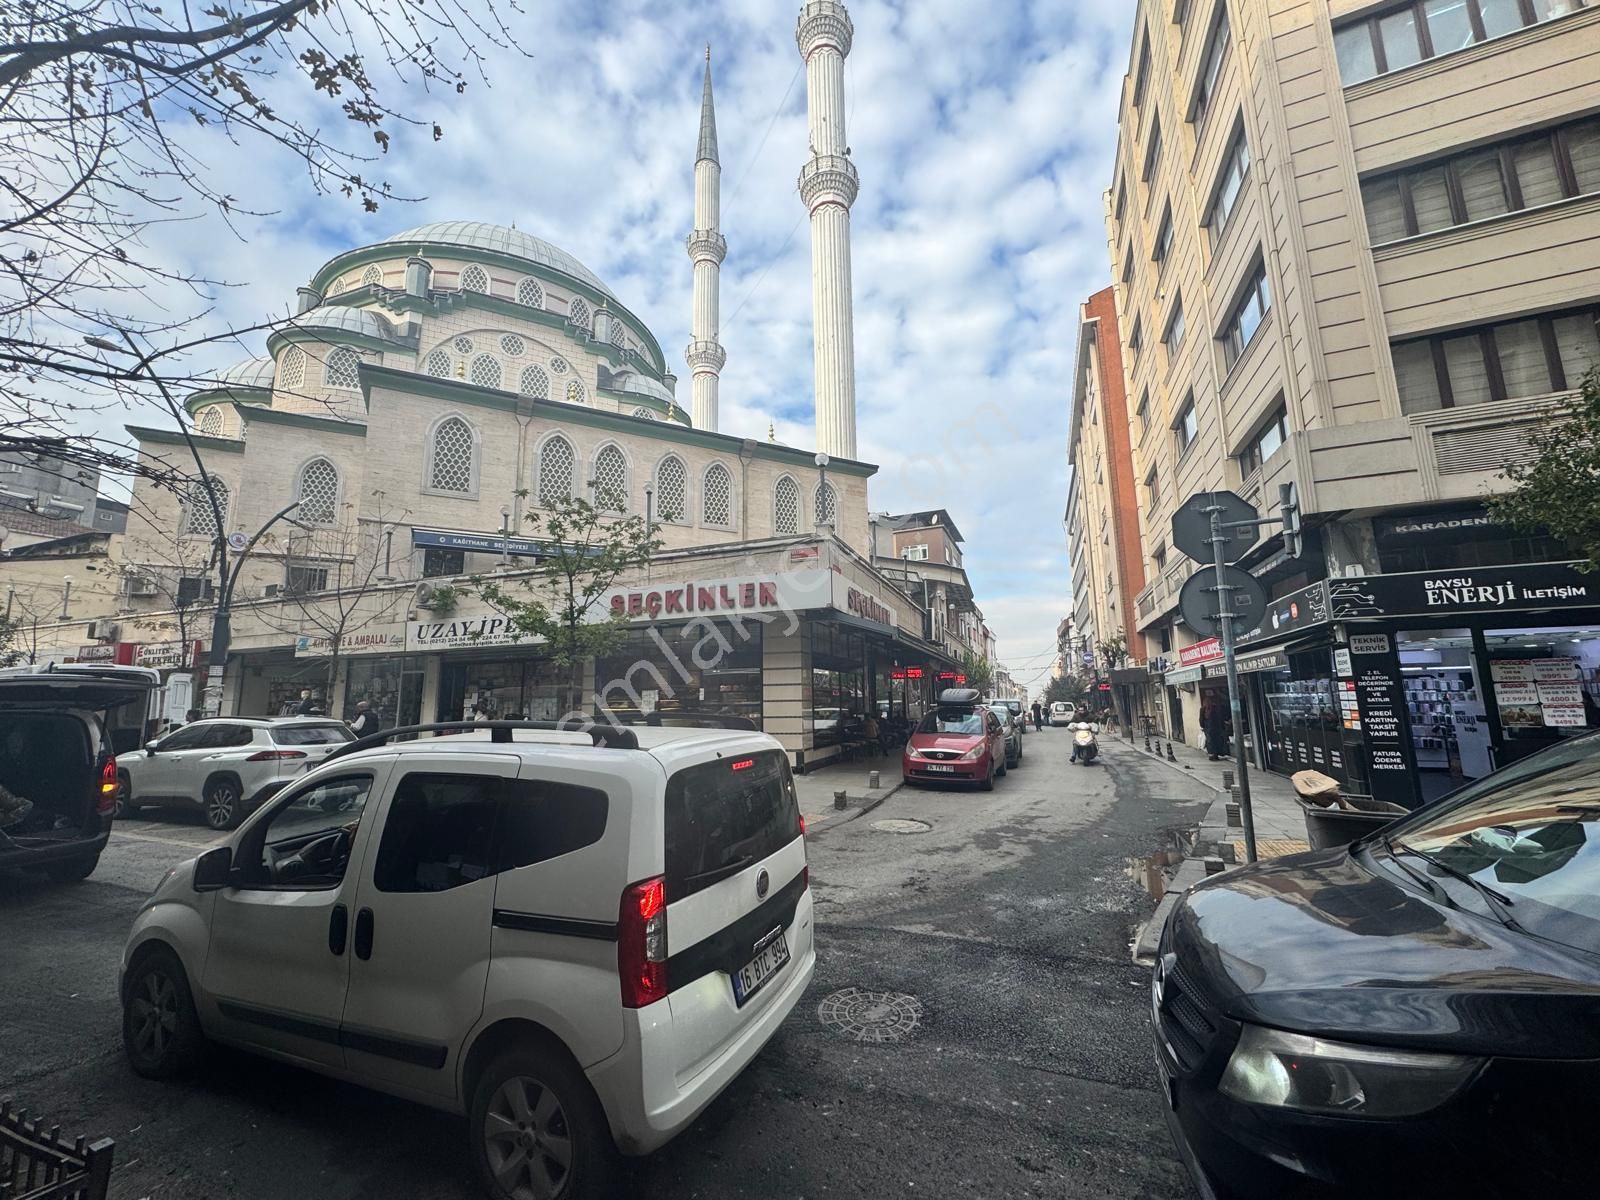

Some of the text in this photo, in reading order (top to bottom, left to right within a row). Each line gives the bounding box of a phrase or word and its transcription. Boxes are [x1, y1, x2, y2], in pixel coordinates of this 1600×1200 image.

[1424, 577, 1472, 589] BAYSU
[610, 581, 778, 618] SEÇKİNLER
[1425, 581, 1586, 605] ENERJİ İLETİŞİM
[416, 620, 473, 640] UZAY
[354, 634, 387, 645] AMBALAJ
[1352, 635, 1386, 644] TEKNİK
[1354, 644, 1386, 652] SERVİS
[740, 967, 752, 993] 16
[753, 951, 771, 981] BTC
[771, 936, 787, 964] 994
